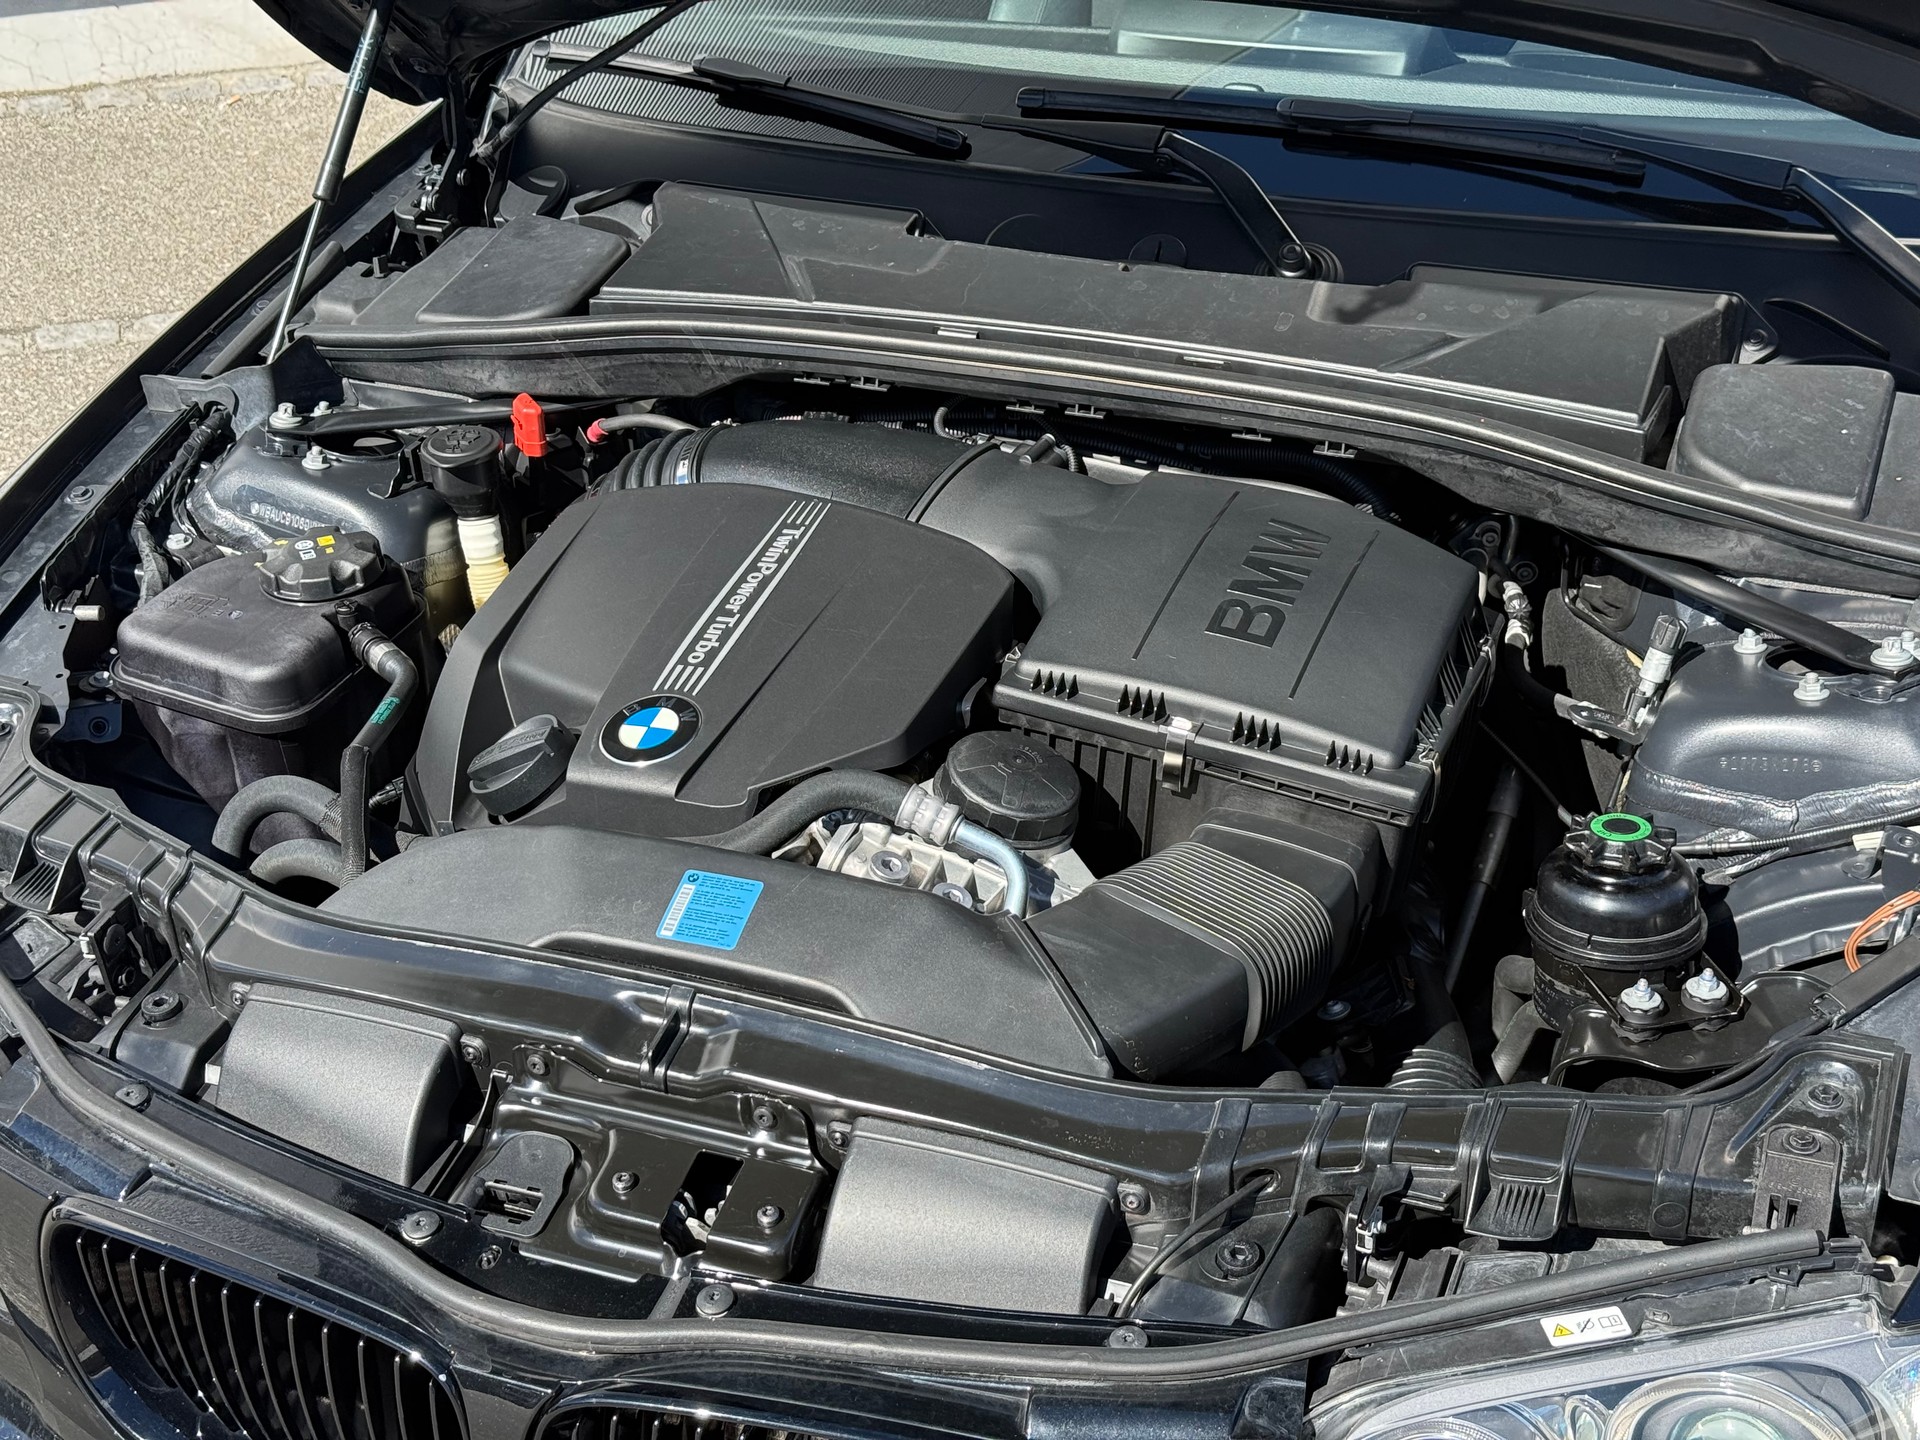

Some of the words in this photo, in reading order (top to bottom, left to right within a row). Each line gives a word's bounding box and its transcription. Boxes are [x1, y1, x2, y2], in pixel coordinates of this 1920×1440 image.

[725, 526, 806, 613] TwinPower
[1203, 518, 1332, 649] BMW
[687, 613, 741, 664] Turbo
[622, 697, 697, 721] BMW
